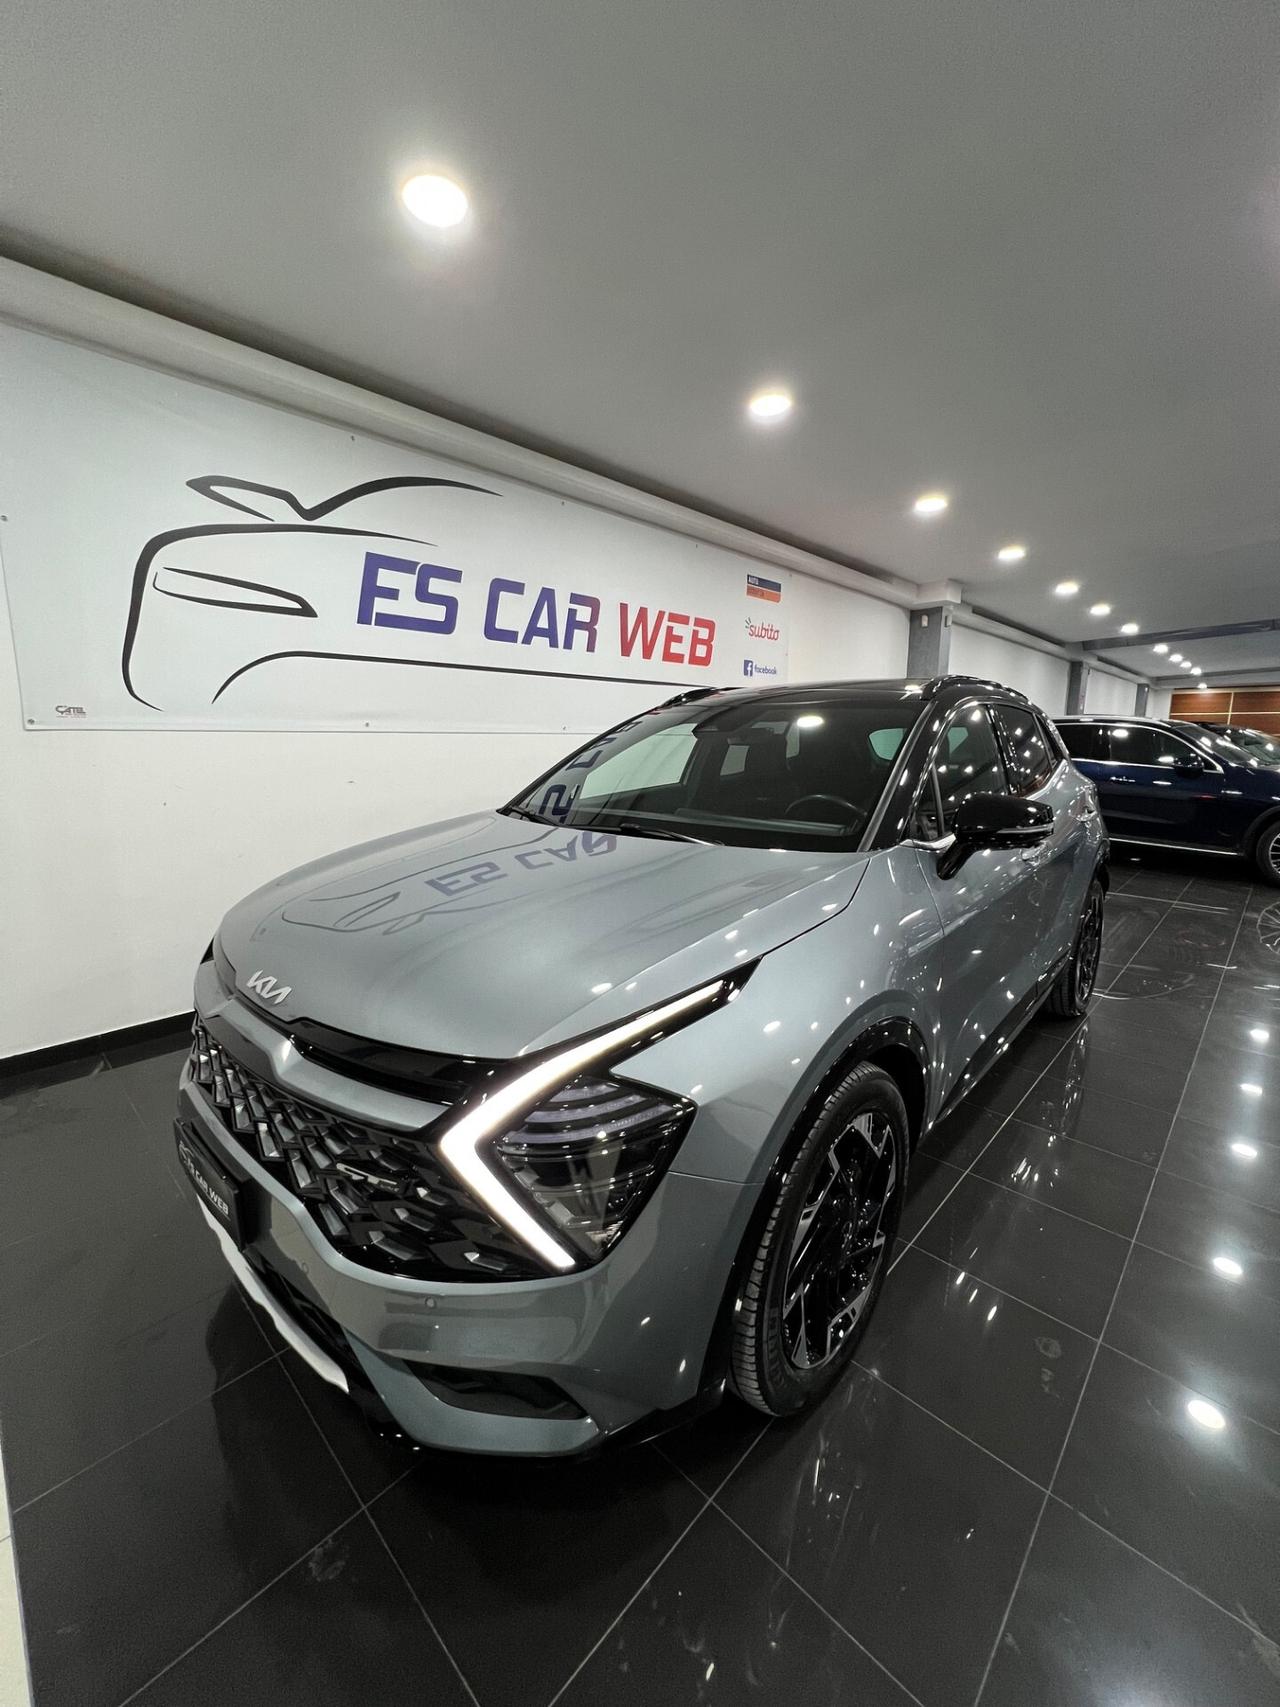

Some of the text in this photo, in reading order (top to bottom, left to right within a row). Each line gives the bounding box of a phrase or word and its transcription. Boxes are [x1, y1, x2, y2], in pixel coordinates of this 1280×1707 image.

[356, 551, 716, 667] ES CAR WEB
[748, 622, 780, 640] subito
[754, 664, 776, 674] facebook
[209, 1187, 229, 1215] WEB
